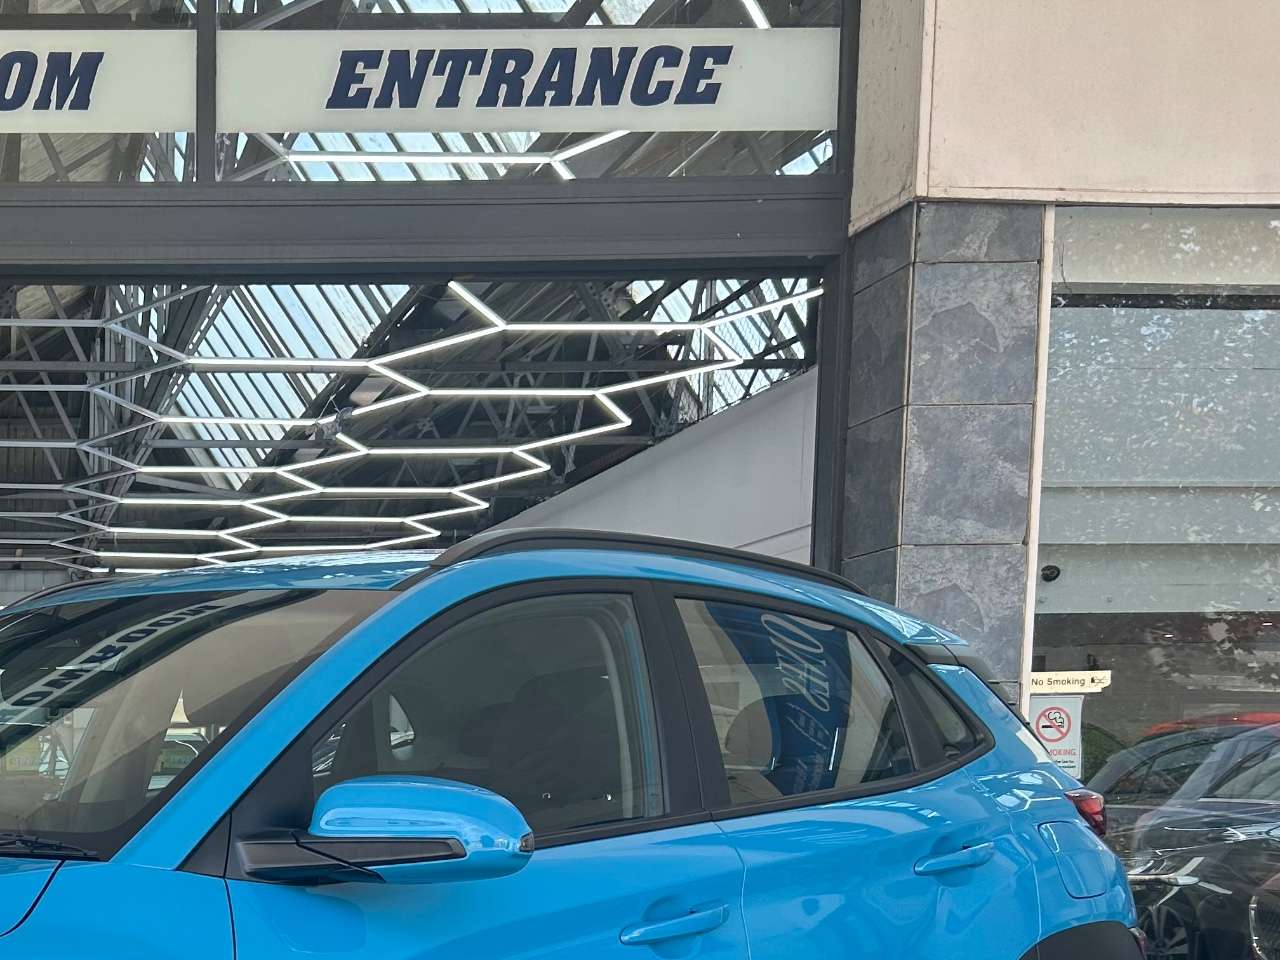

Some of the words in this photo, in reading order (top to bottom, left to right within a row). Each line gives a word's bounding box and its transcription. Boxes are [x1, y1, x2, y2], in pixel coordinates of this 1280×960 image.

[325, 45, 734, 109] ENTRANCE
[1031, 678, 1044, 686] No
[1047, 677, 1086, 687] Smoking
